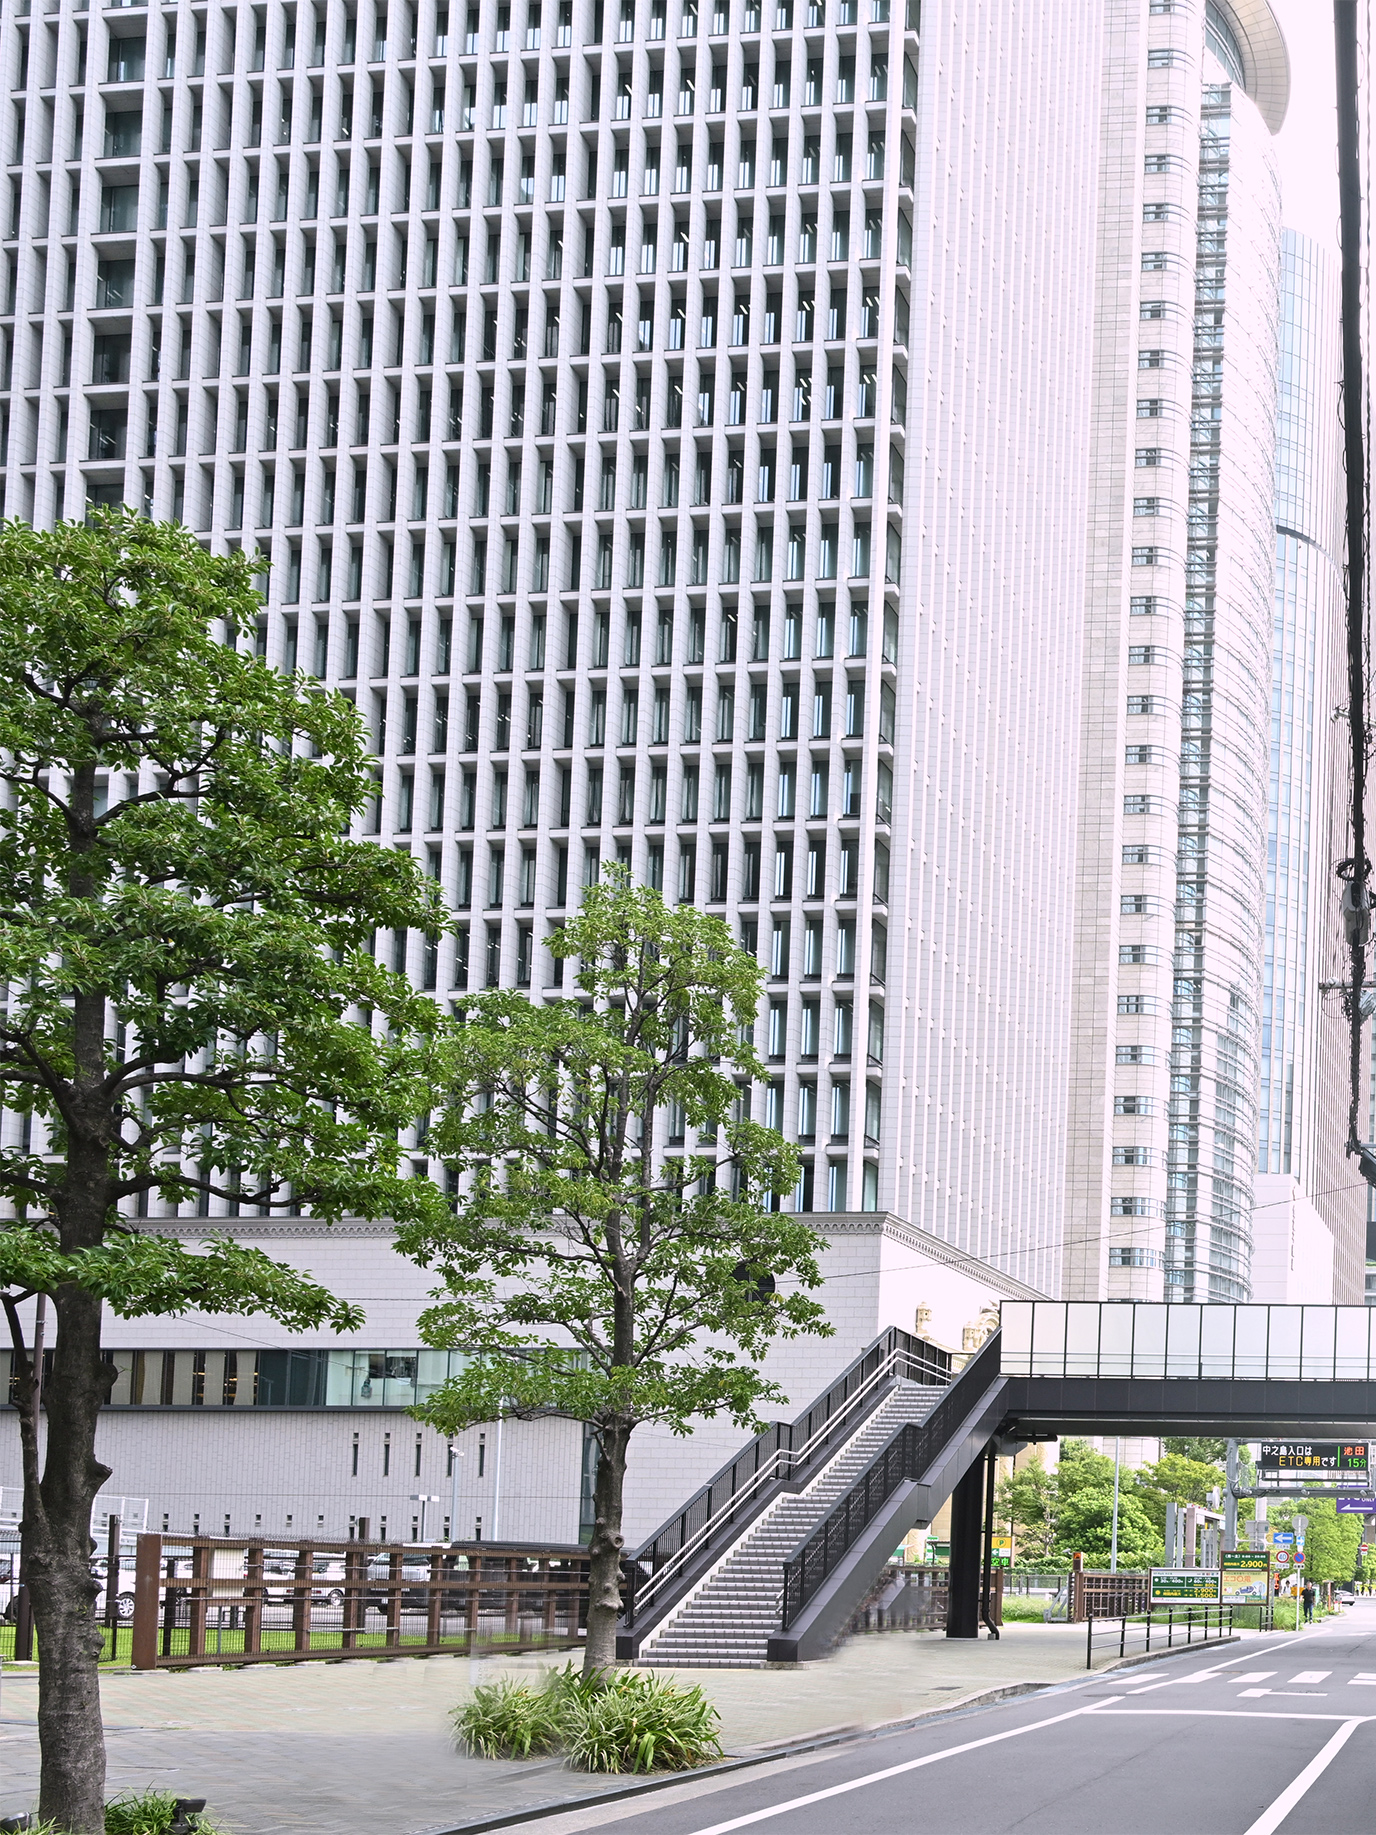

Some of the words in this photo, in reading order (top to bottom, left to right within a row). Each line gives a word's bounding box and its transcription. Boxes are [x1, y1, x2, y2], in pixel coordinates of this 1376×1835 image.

[1262, 1446, 1312, 1456] 中之島入口は
[1344, 1446, 1365, 1456] 池田
[1279, 1456, 1337, 1467] ETC専用です
[1348, 1458, 1366, 1468] 15分
